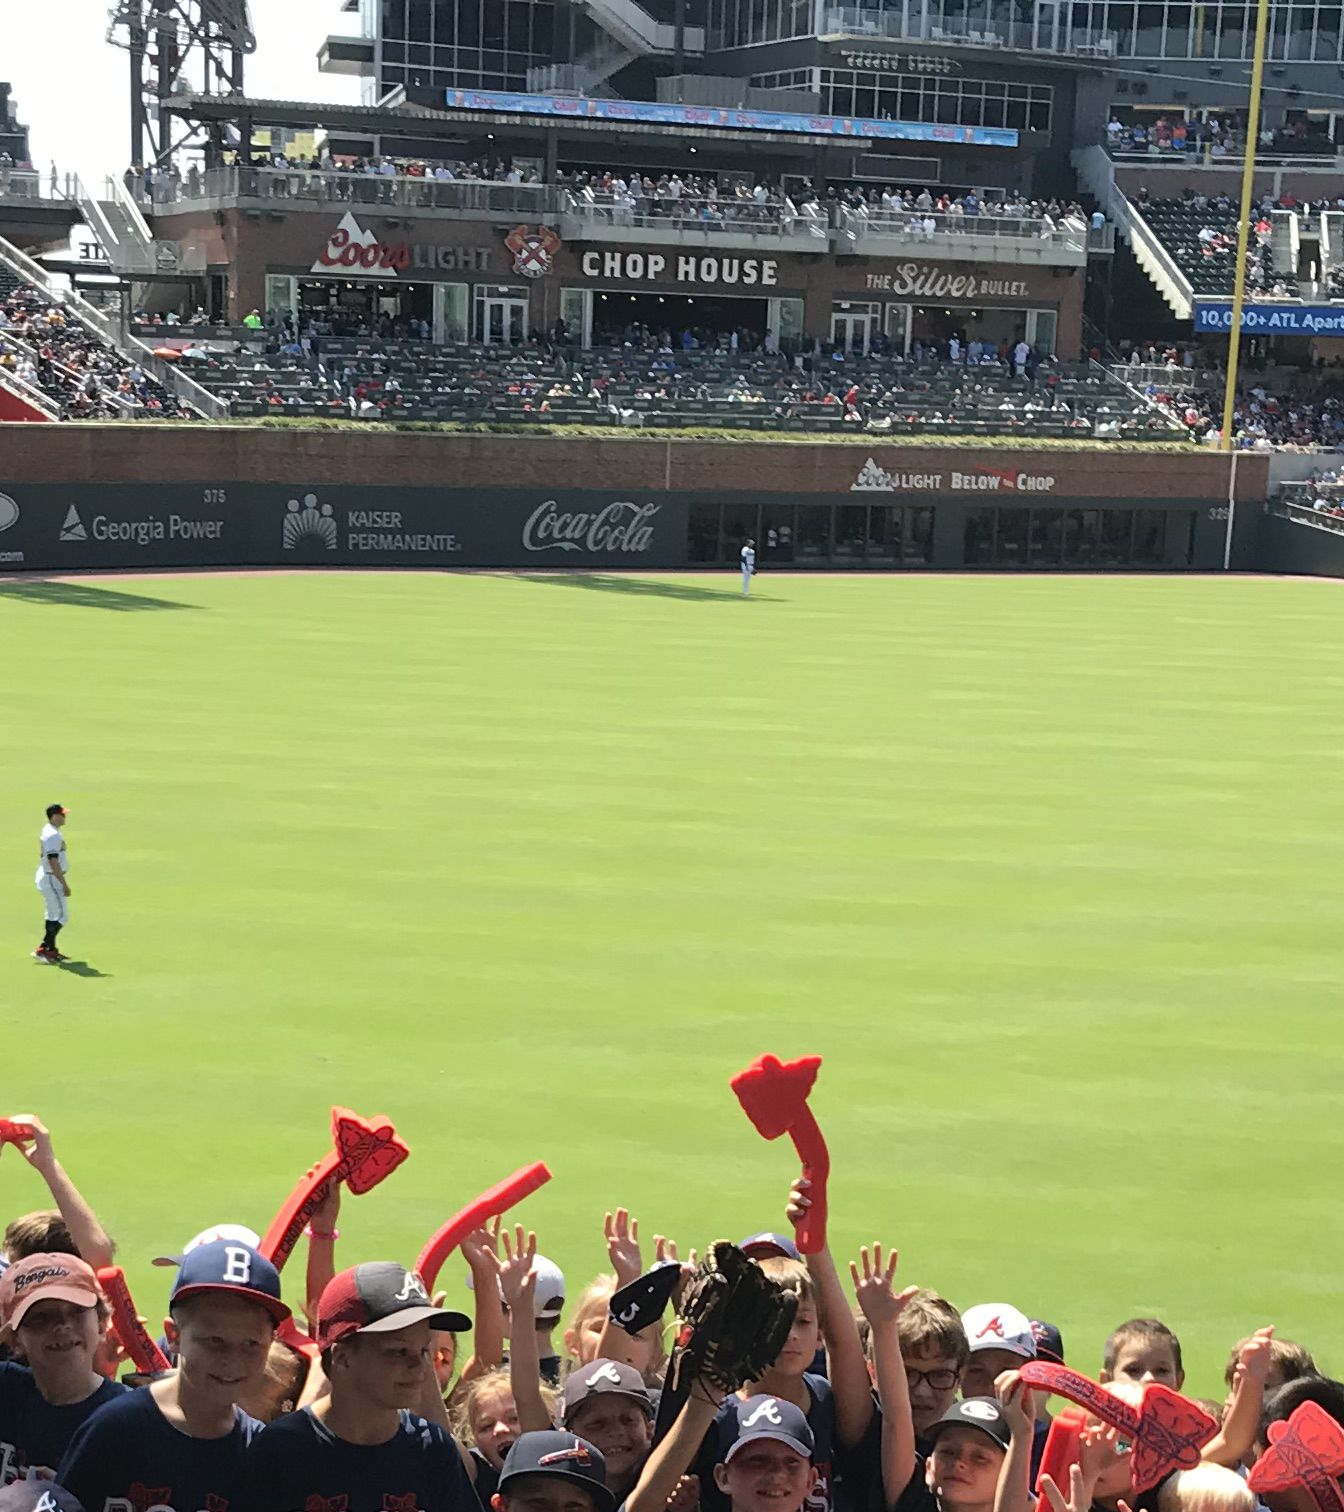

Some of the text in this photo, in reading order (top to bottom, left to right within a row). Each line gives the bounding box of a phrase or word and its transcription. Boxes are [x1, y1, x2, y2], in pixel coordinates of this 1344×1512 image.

[411, 246, 492, 270] LIGHT
[583, 251, 665, 280] CHOP
[677, 257, 778, 285] HOUSE
[867, 275, 892, 290] THE
[893, 262, 978, 299] Silver
[1269, 312, 1299, 329] ATL
[901, 474, 942, 489] LIGHT
[203, 489, 227, 504] 375
[92, 514, 226, 545] Georgia Power
[348, 511, 402, 528] KAISER
[522, 500, 662, 553] Coca-Cola
[348, 533, 457, 551] PERMANENTE
[223, 1247, 252, 1284] B
[13, 1266, 70, 1294] Bengals
[395, 1271, 428, 1302] A
[975, 1316, 1006, 1339] A
[585, 1360, 622, 1387] A
[741, 1398, 783, 1428] A
